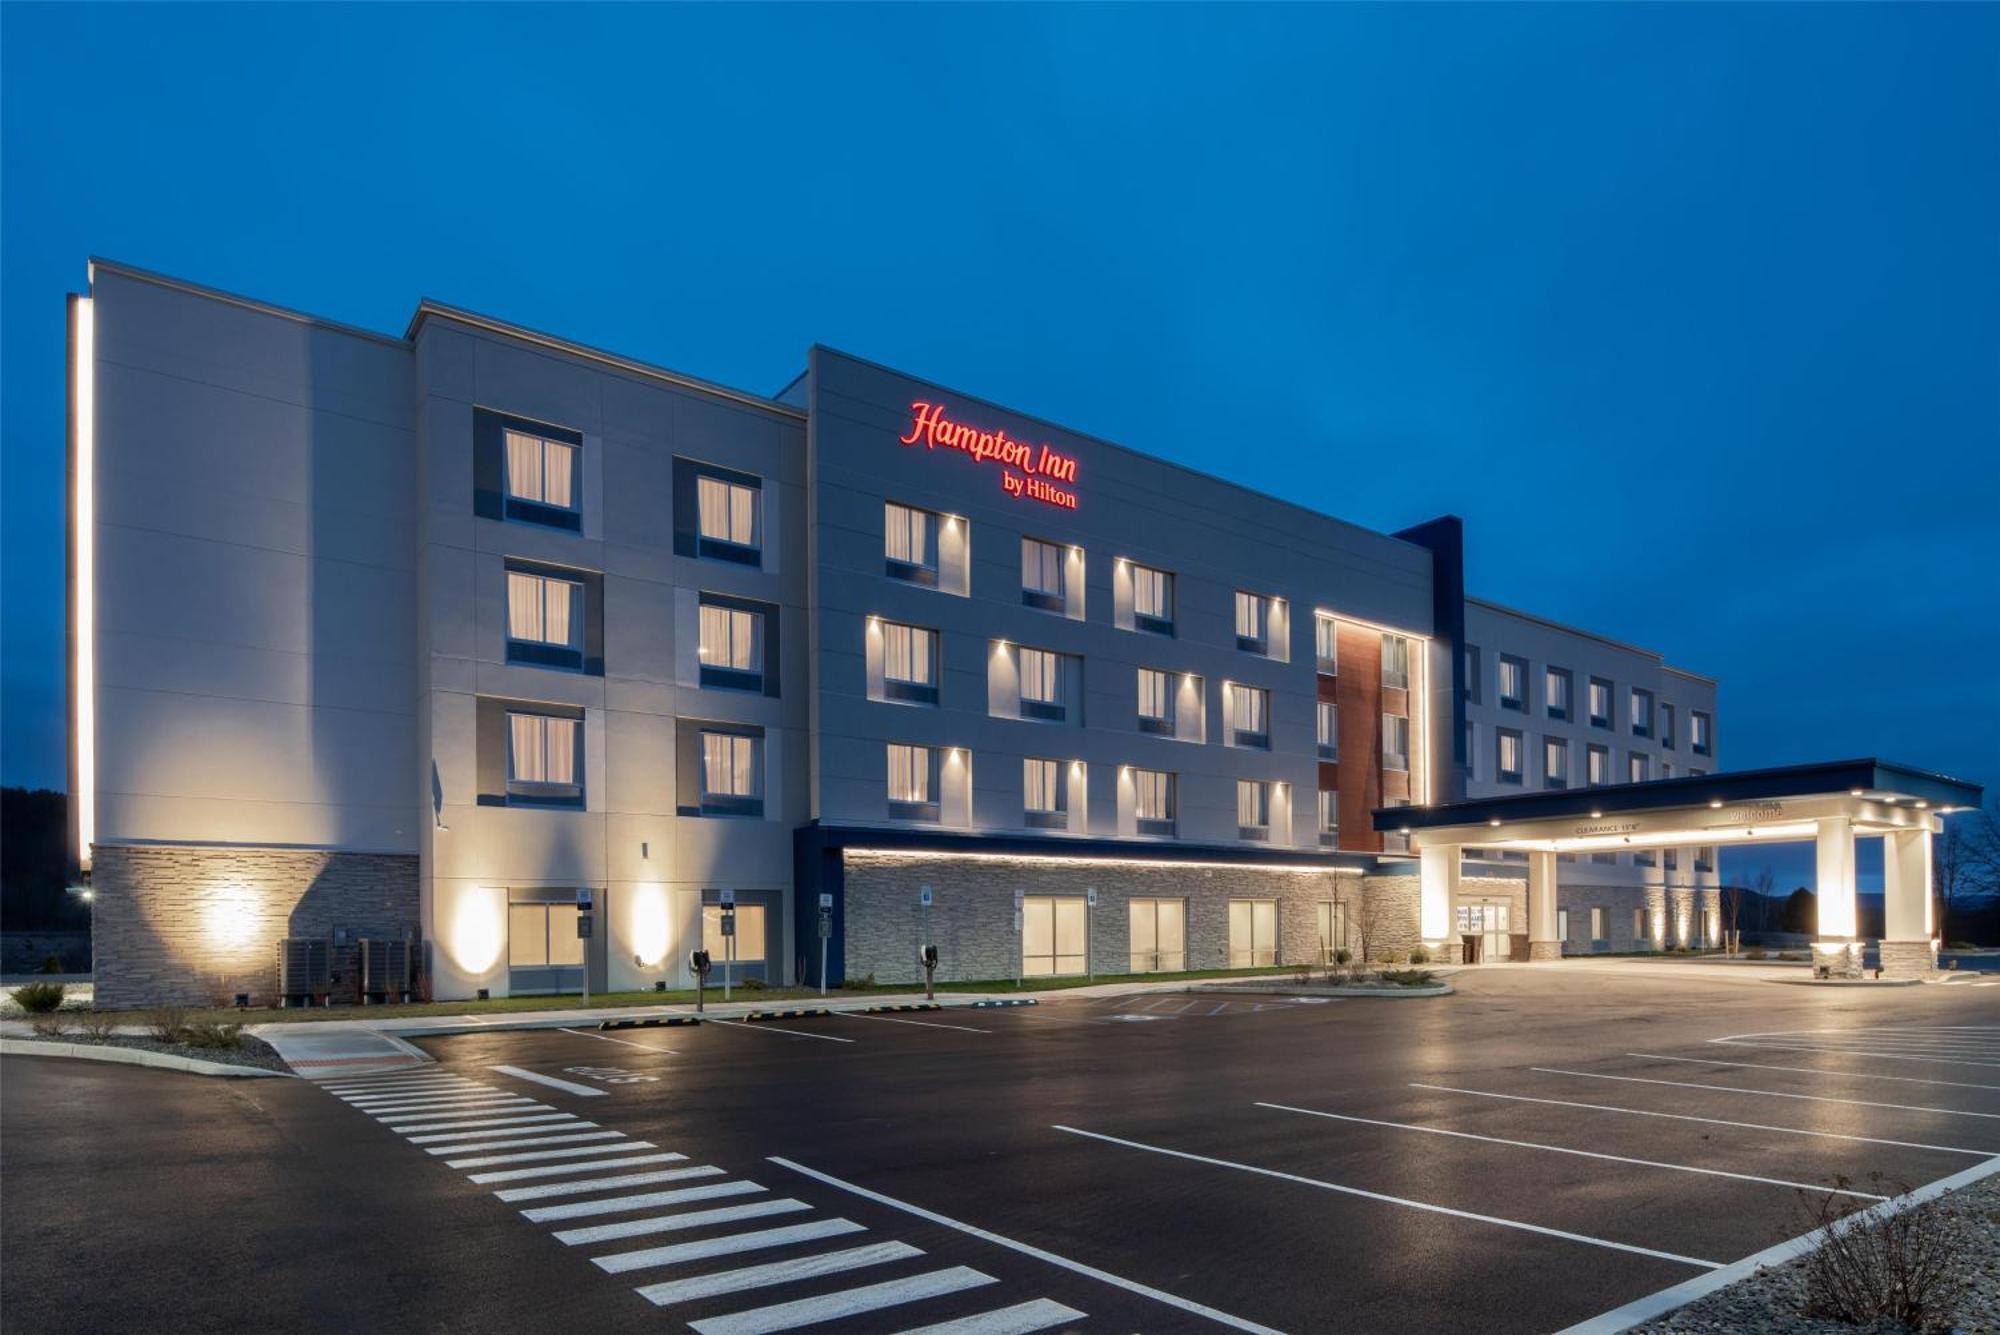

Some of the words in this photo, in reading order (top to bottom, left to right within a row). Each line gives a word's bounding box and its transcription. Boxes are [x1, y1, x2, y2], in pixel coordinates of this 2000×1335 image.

[900, 402, 1036, 474] Hampton
[1038, 444, 1077, 482] Inn
[1003, 471, 1025, 497] by
[1026, 477, 1078, 509] Hilton
[1575, 824, 1618, 835] CLEARANCE
